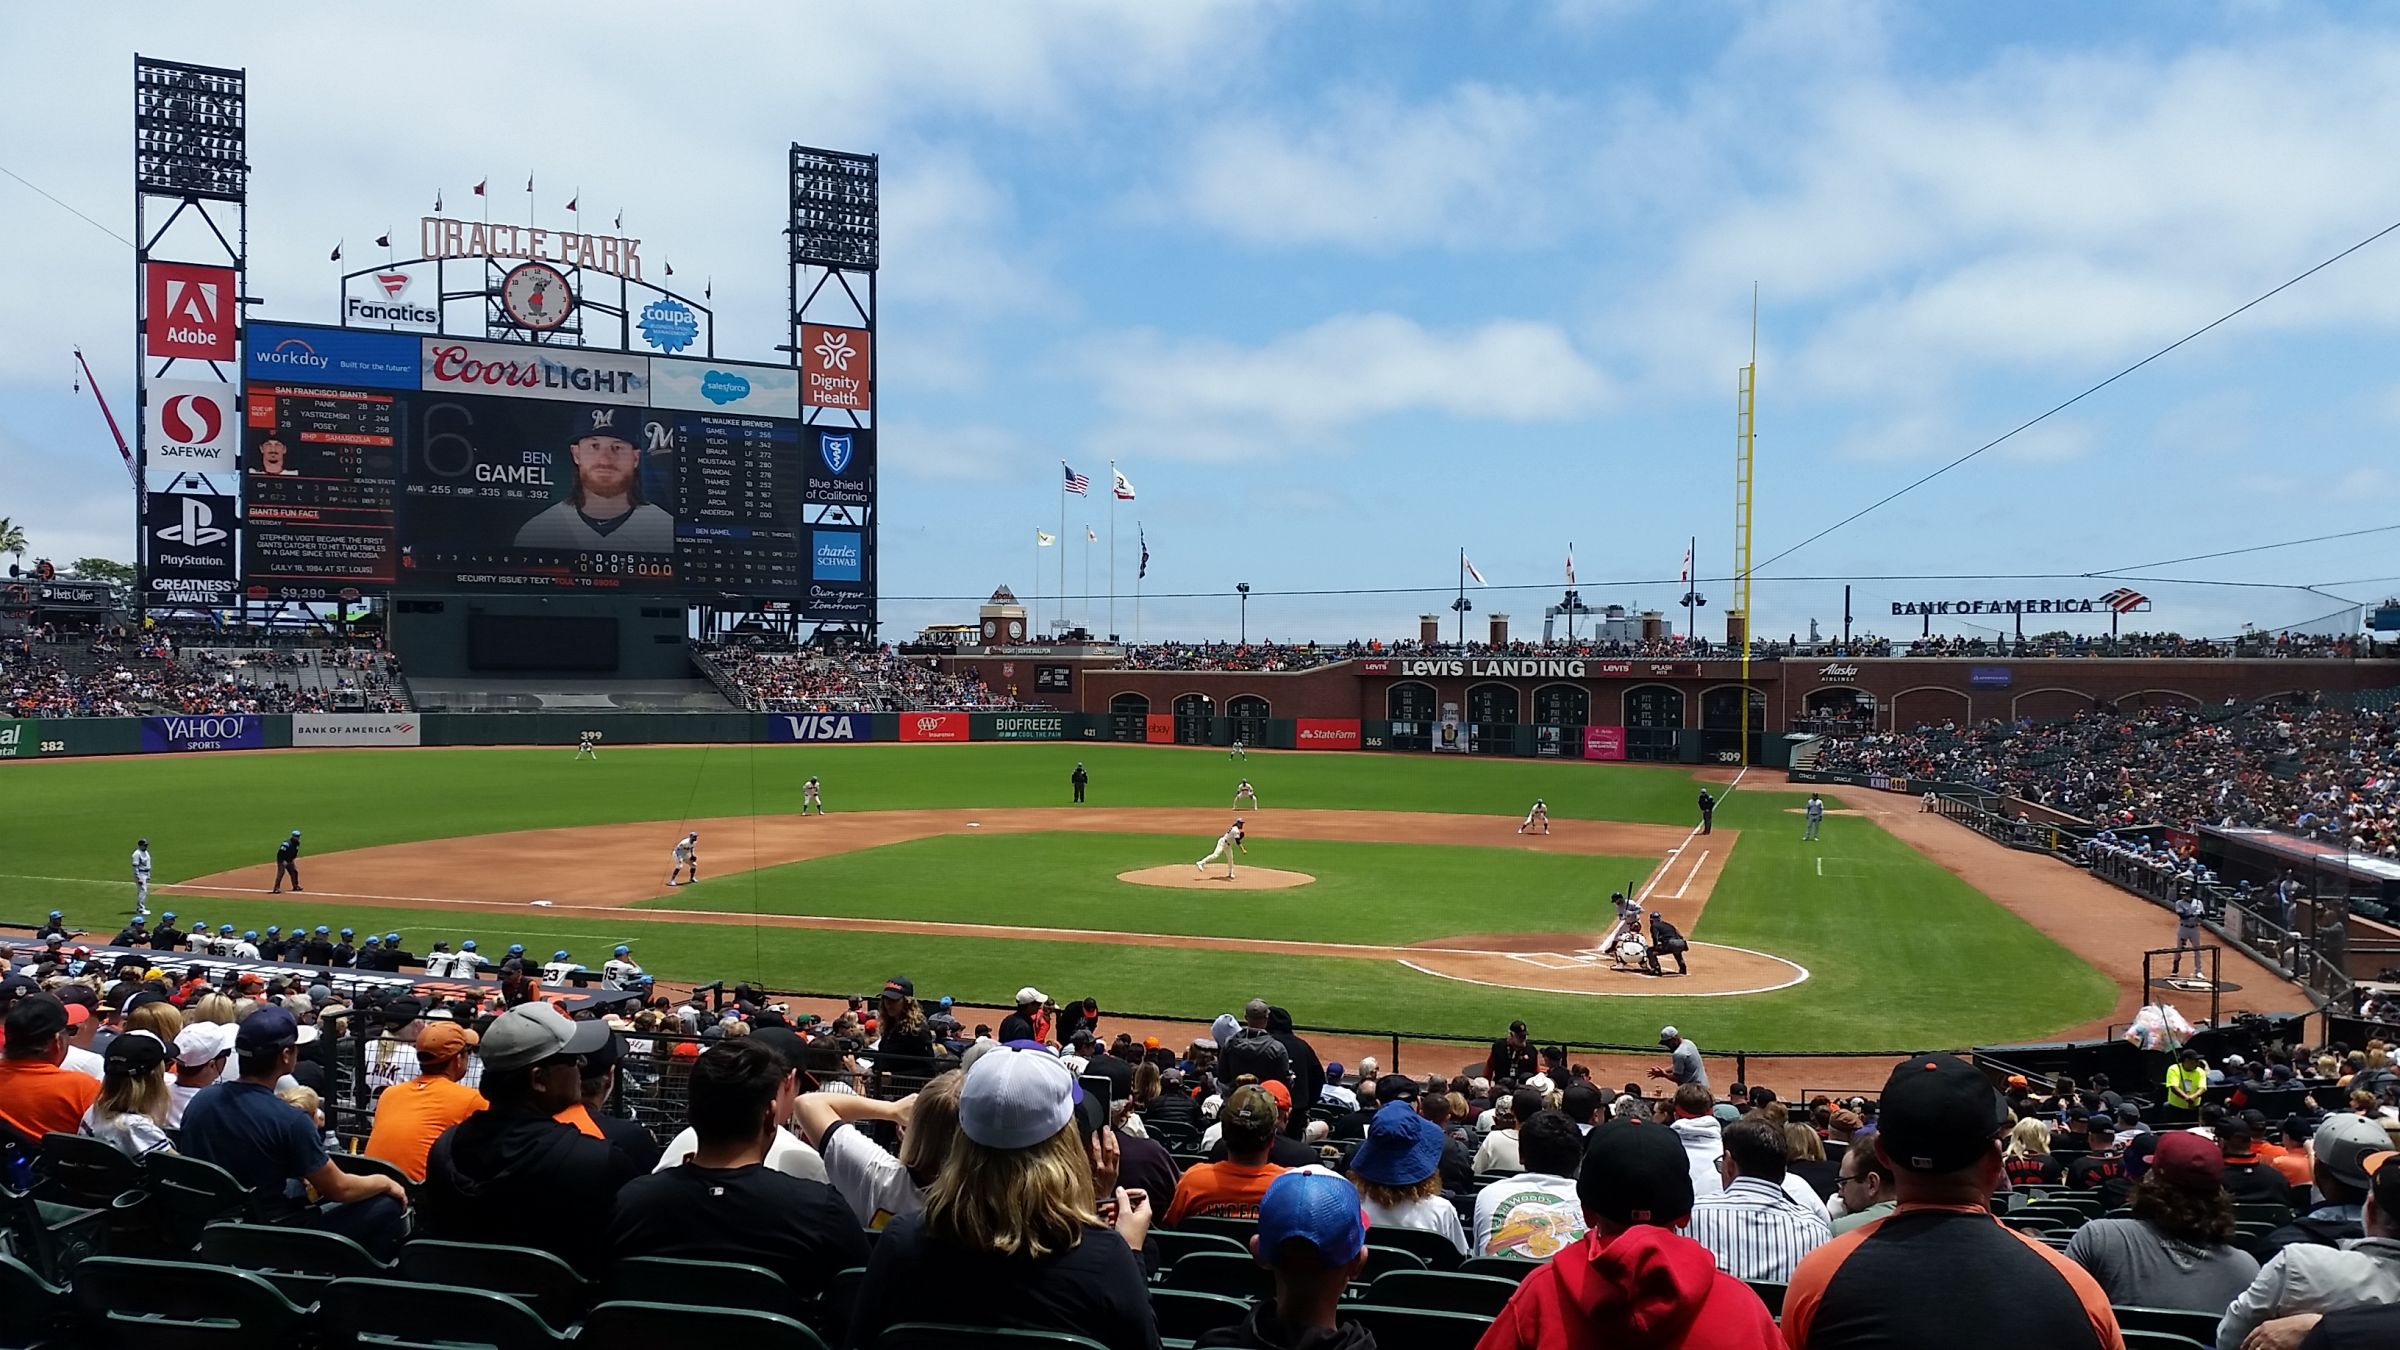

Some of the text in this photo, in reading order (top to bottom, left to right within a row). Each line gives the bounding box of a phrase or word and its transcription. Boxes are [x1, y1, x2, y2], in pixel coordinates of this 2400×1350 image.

[421, 217, 643, 283] ORACLE PARK
[349, 299, 437, 325] Fanatics
[646, 308, 693, 326] coupa
[167, 326, 217, 345] Adobe
[256, 351, 329, 369] workday
[340, 360, 358, 368] Built
[359, 361, 370, 370] for
[371, 362, 384, 371] the
[432, 345, 633, 394] Coors LIGHT
[707, 382, 746, 393] salesforce
[810, 373, 860, 393] Dignity
[293, 388, 338, 397] FRANCISCO
[339, 390, 368, 399] GIANTS
[813, 389, 858, 406] Health
[314, 400, 337, 408] PANIK
[300, 410, 351, 420] YASTRZEMSKI
[280, 420, 292, 428] 28
[313, 422, 338, 430] POSEY
[700, 416, 774, 429] MILWAUKEE BREWERS
[705, 427, 728, 436] GAMEL
[160, 445, 221, 459] SAFEWAY
[523, 451, 552, 465] BEN
[697, 458, 737, 467] MOUSTAKAS
[475, 463, 555, 486] GAMEL
[702, 467, 732, 476] GRANDAL
[704, 478, 730, 486] THAMES
[809, 478, 864, 492] Blue Shield
[406, 484, 549, 499] AVG .255 OBP .335 SLG .392
[707, 488, 727, 496] SHAW
[805, 489, 868, 502] of California
[249, 507, 319, 518] GIANTS FUN FACT
[699, 509, 735, 517] ANDERSON
[695, 527, 709, 535] BEN
[259, 533, 384, 545] STEPHEN VOGT BECAME THE FIRST
[256, 541, 282, 549] GIANTS
[283, 541, 317, 550] CATCHER
[317, 542, 328, 550] TO
[328, 543, 340, 551] HIT
[359, 544, 387, 552] TRIPLES
[817, 544, 857, 557] charles
[279, 549, 300, 557] GAME
[301, 550, 323, 558] SINCE
[325, 550, 348, 558] STEVE
[160, 554, 223, 568] PlayStation
[817, 558, 857, 567] SCHWAB
[306, 564, 323, 572] 1984
[324, 565, 334, 573] AT
[151, 578, 232, 592] GREATNESS
[456, 574, 497, 583] SECURITY
[498, 575, 528, 584] ISSUE?
[530, 575, 550, 584] TEXT
[71, 588, 94, 602] Coffee
[166, 590, 219, 603] AWAITS
[280, 586, 326, 599] $9,290
[809, 585, 864, 603] Own your
[808, 599, 867, 610] tomorrow
[1891, 598, 2093, 616] BANK OF AMERICA
[1472, 661, 1586, 678] LANDING
[1819, 663, 1859, 676] Alaska
[163, 716, 244, 741] YAHOO!
[298, 726, 391, 734] BANK OF AMERICA
[784, 715, 854, 740] VISA
[1083, 728, 1096, 737] 421
[1148, 723, 1170, 735] ebay
[580, 731, 603, 740] 399
[1366, 736, 1383, 747] 365
[40, 740, 65, 752] 382
[187, 740, 221, 750] SPORTS
[1719, 751, 1741, 763] 309
[543, 968, 560, 982] 23
[603, 966, 618, 981] 15
